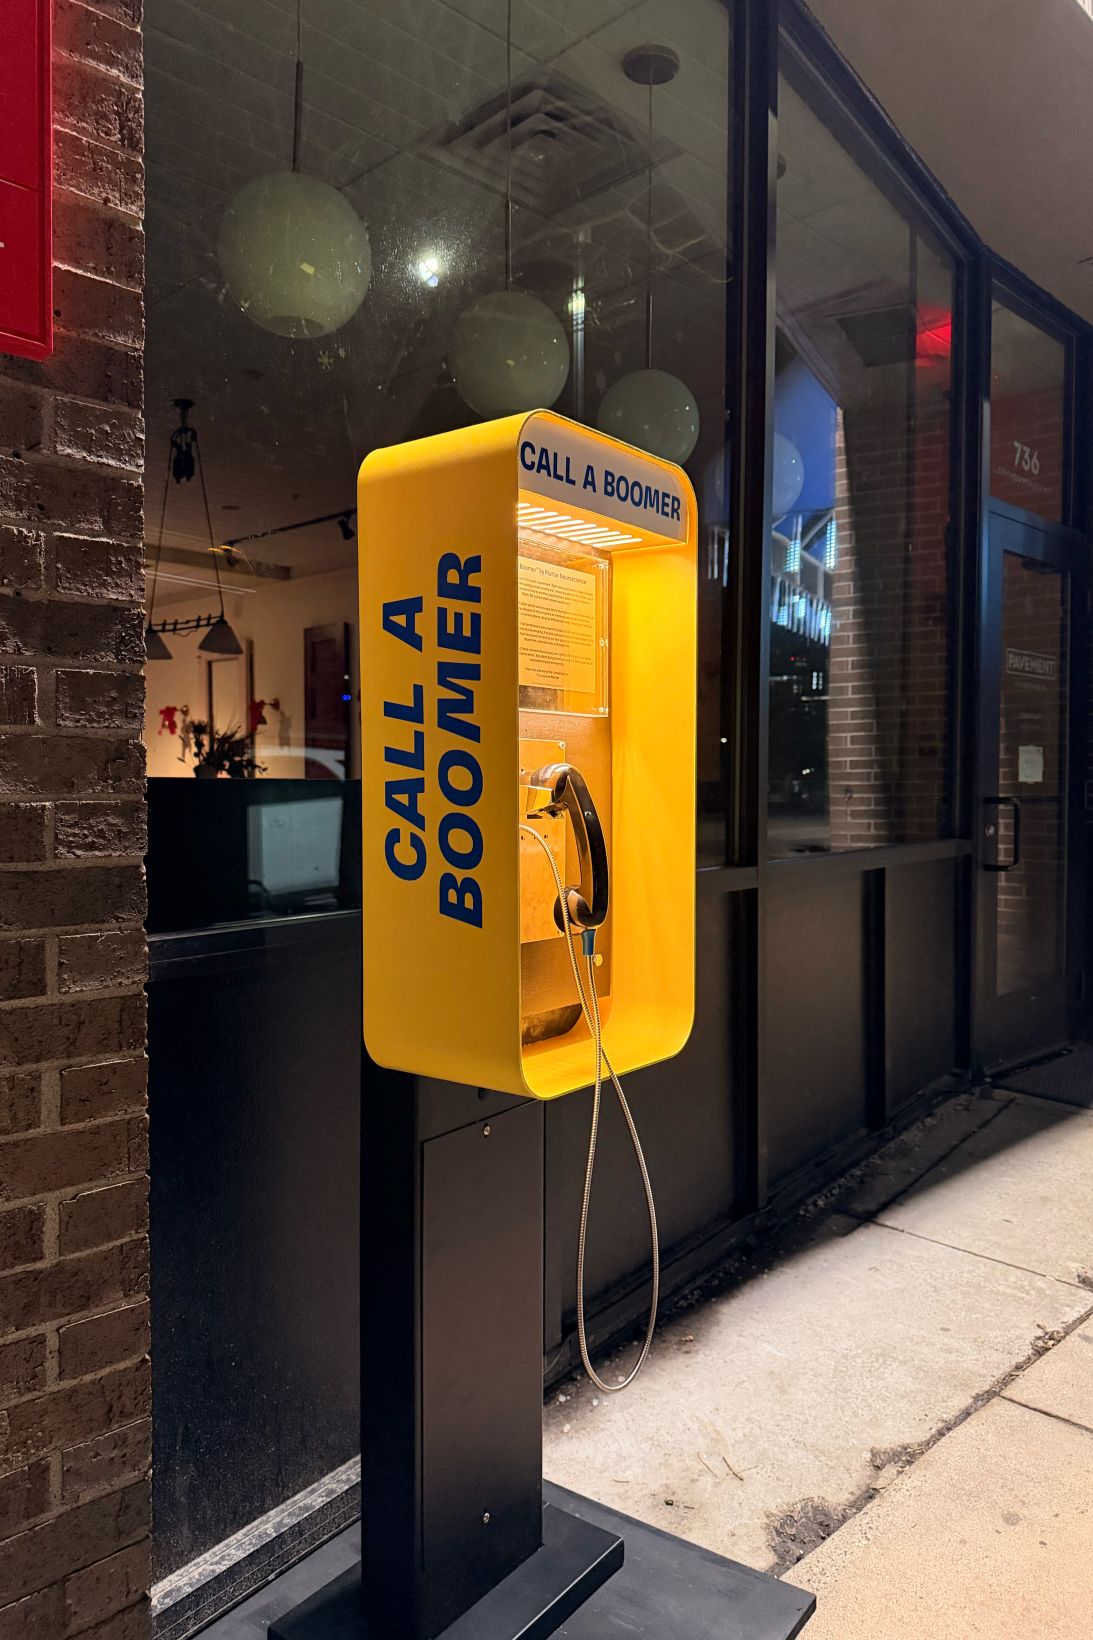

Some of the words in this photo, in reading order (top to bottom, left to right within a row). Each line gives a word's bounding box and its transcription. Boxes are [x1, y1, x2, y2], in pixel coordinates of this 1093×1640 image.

[520, 441, 576, 486] CALL
[582, 464, 597, 493] A
[603, 469, 681, 521] BOOMER
[1013, 440, 1040, 475] 736
[382, 596, 424, 653] A
[1008, 653, 1056, 677] PAVEMENT
[437, 552, 484, 929] BOOMER
[384, 683, 427, 881] CALL
